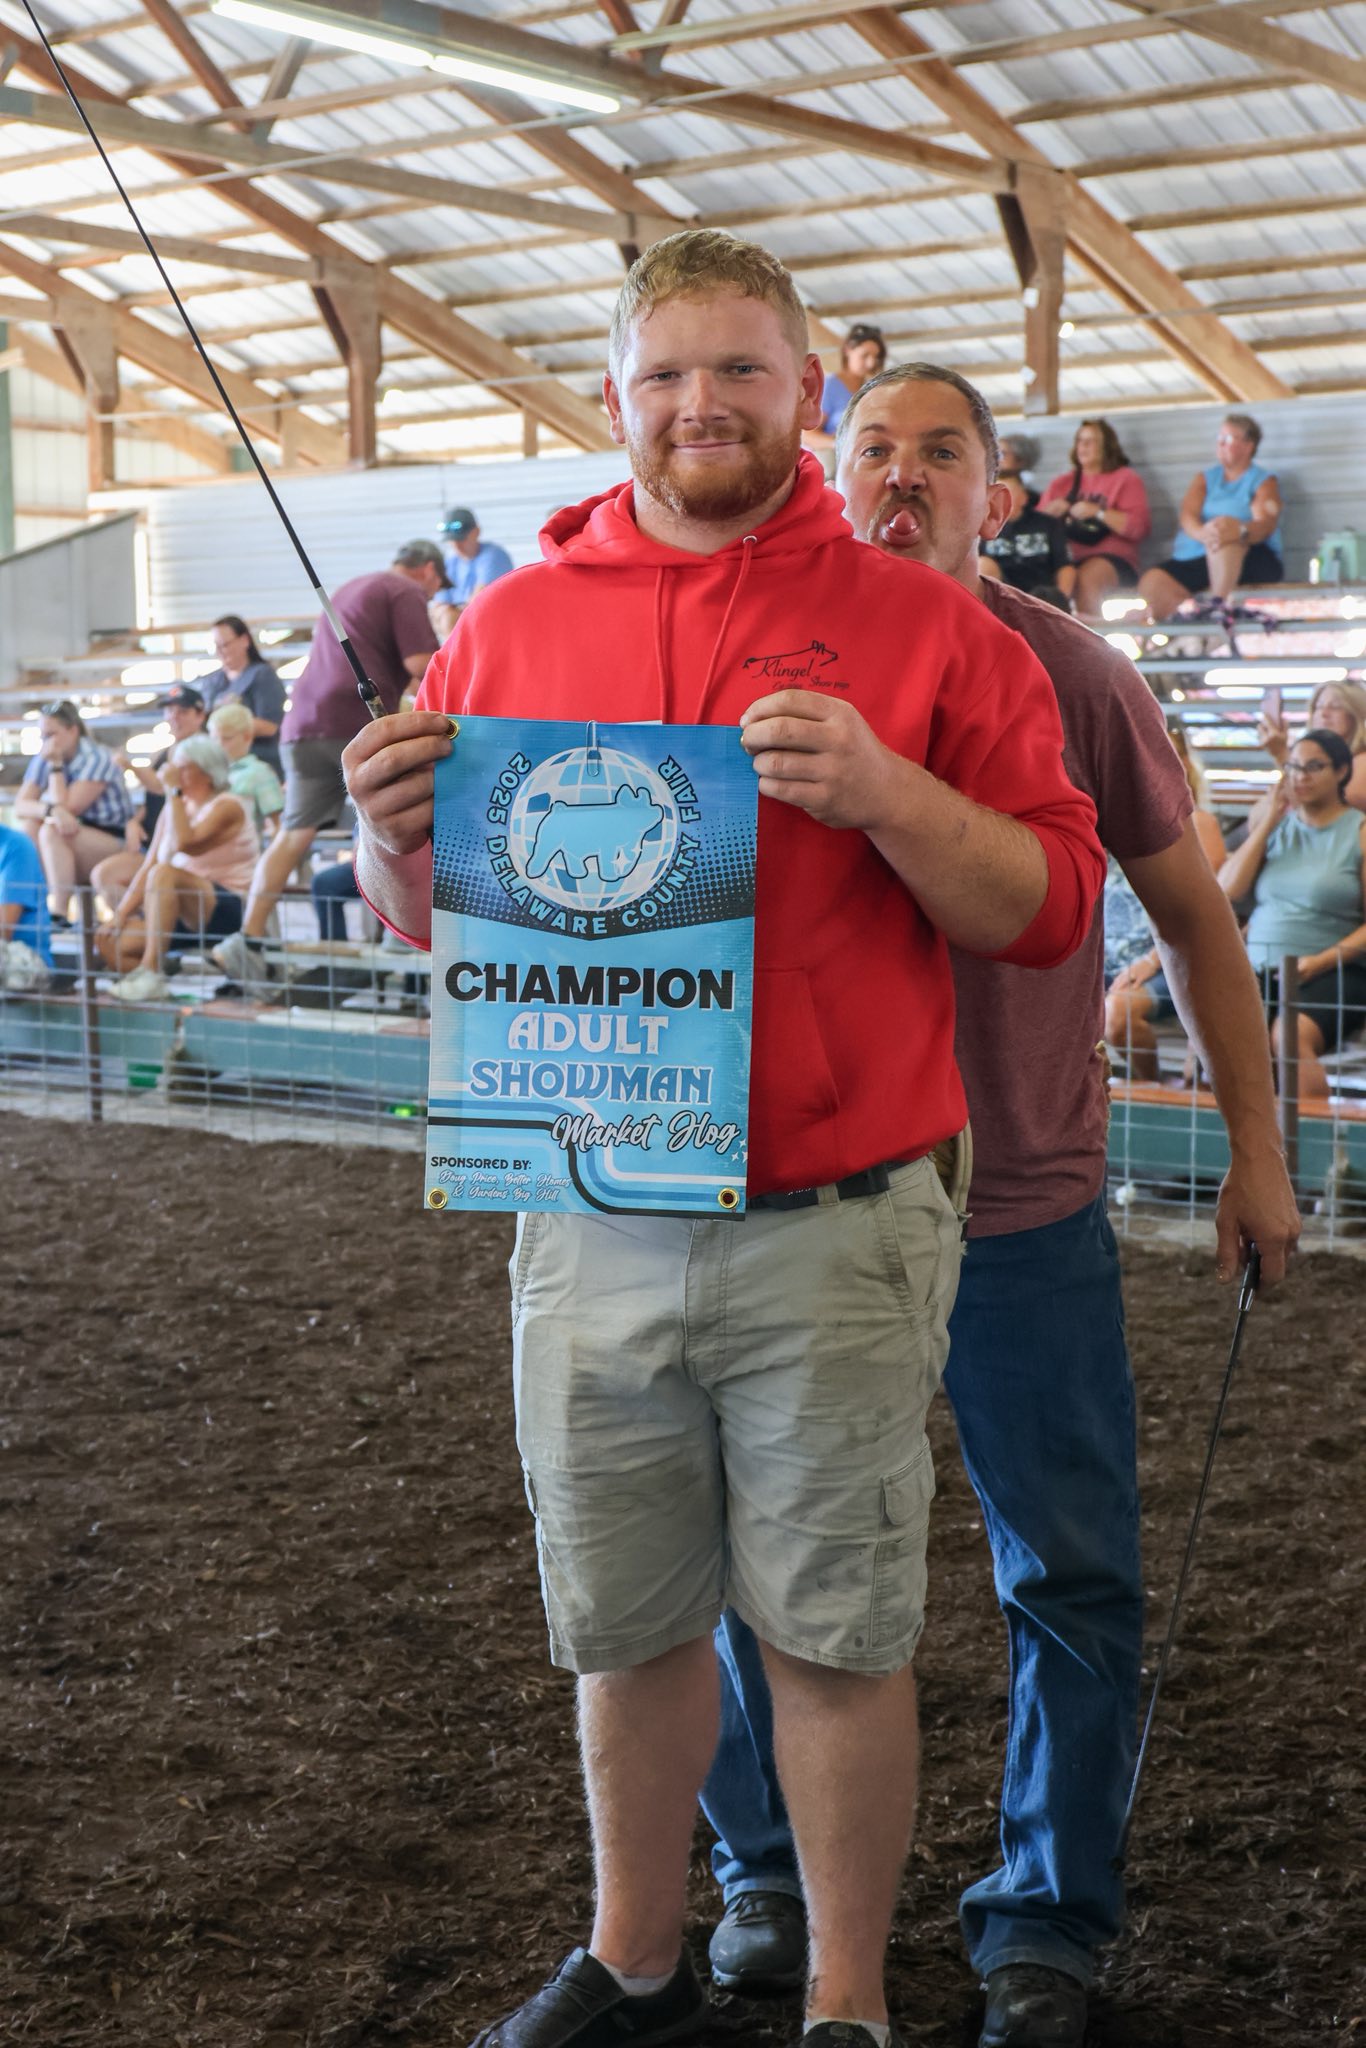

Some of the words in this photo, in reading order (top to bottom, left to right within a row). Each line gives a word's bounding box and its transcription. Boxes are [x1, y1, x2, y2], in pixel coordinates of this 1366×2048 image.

[752, 658, 814, 681] Klingel
[487, 752, 532, 825] 2025
[658, 754, 701, 824] FAIR
[486, 835, 608, 935] DELAWARE
[621, 835, 700, 928] COUNTY
[445, 961, 734, 1010] CHAMPION
[507, 1011, 669, 1055] ADULT
[469, 1059, 713, 1105] SHOWMAN
[551, 1113, 662, 1152] Market
[668, 1110, 741, 1154] Hog
[431, 1156, 508, 1170] SPONSORED
[513, 1159, 532, 1170] BY:
[439, 1169, 467, 1184] Doug
[471, 1171, 499, 1185] Price,
[504, 1172, 532, 1186] Better
[536, 1173, 572, 1187] Homes
[452, 1185, 464, 1197] &
[469, 1187, 508, 1200] Gardens
[512, 1188, 531, 1202] Big
[535, 1188, 561, 1202] Hill
